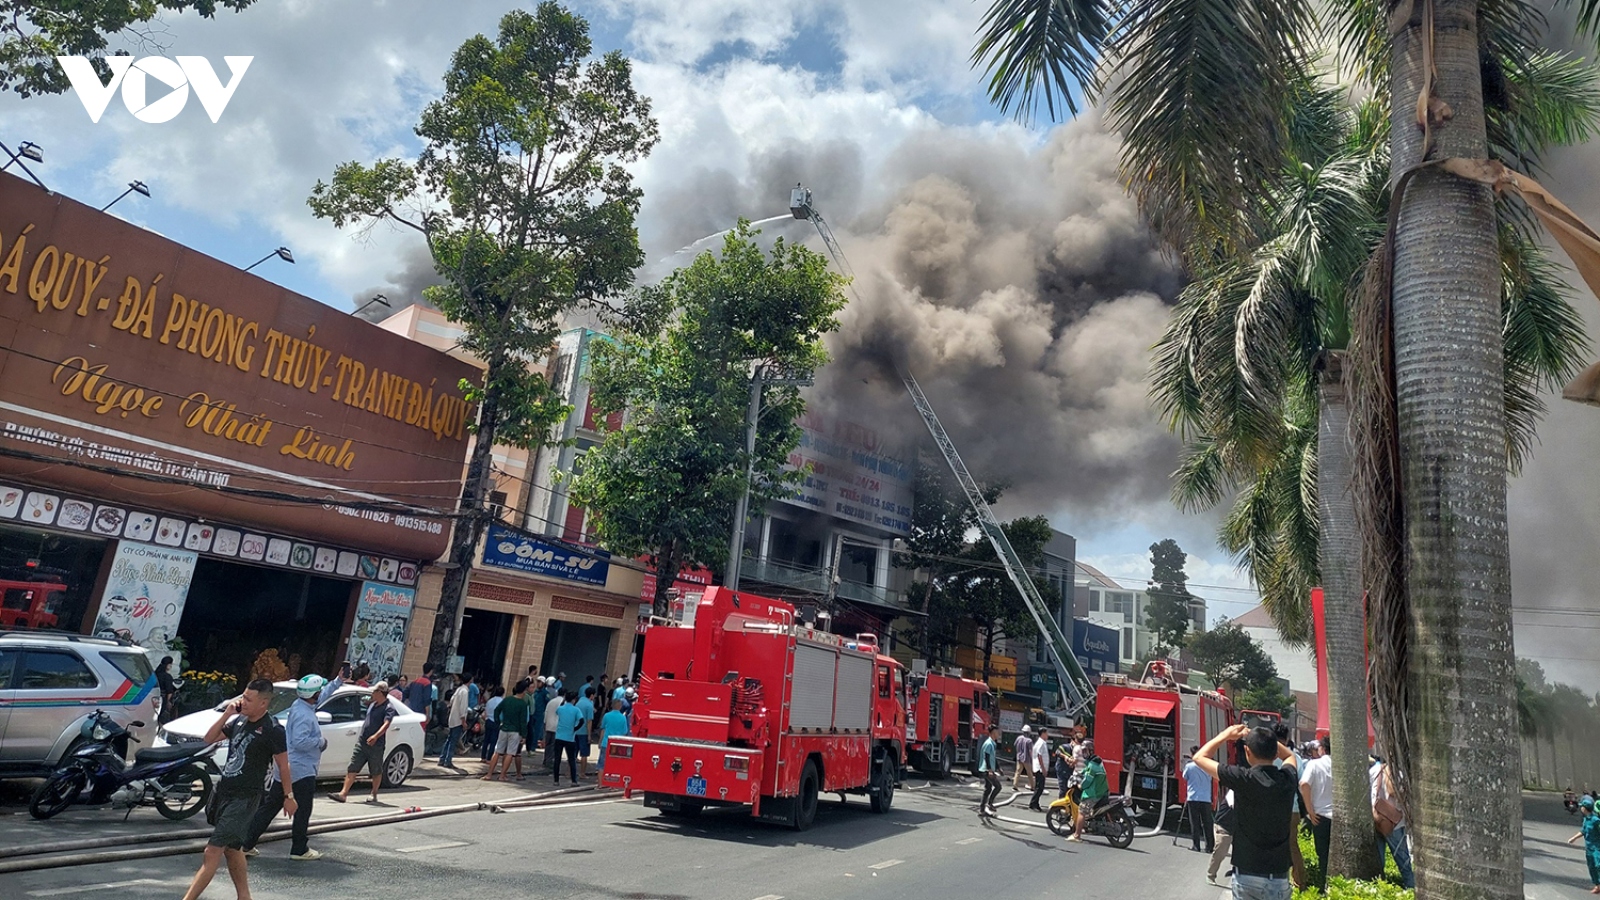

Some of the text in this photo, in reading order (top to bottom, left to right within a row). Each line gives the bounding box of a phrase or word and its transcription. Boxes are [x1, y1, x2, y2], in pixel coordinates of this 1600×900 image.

[0, 223, 35, 294] Á
[112, 273, 164, 338] ĐÁ
[160, 293, 258, 372] PHONG
[404, 377, 437, 430] ĐÁ
[51, 356, 355, 471] Ngọc Nhất Linh
[123, 547, 134, 555] CTY
[516, 557, 533, 566] MUA
[534, 559, 551, 569] BÁN
